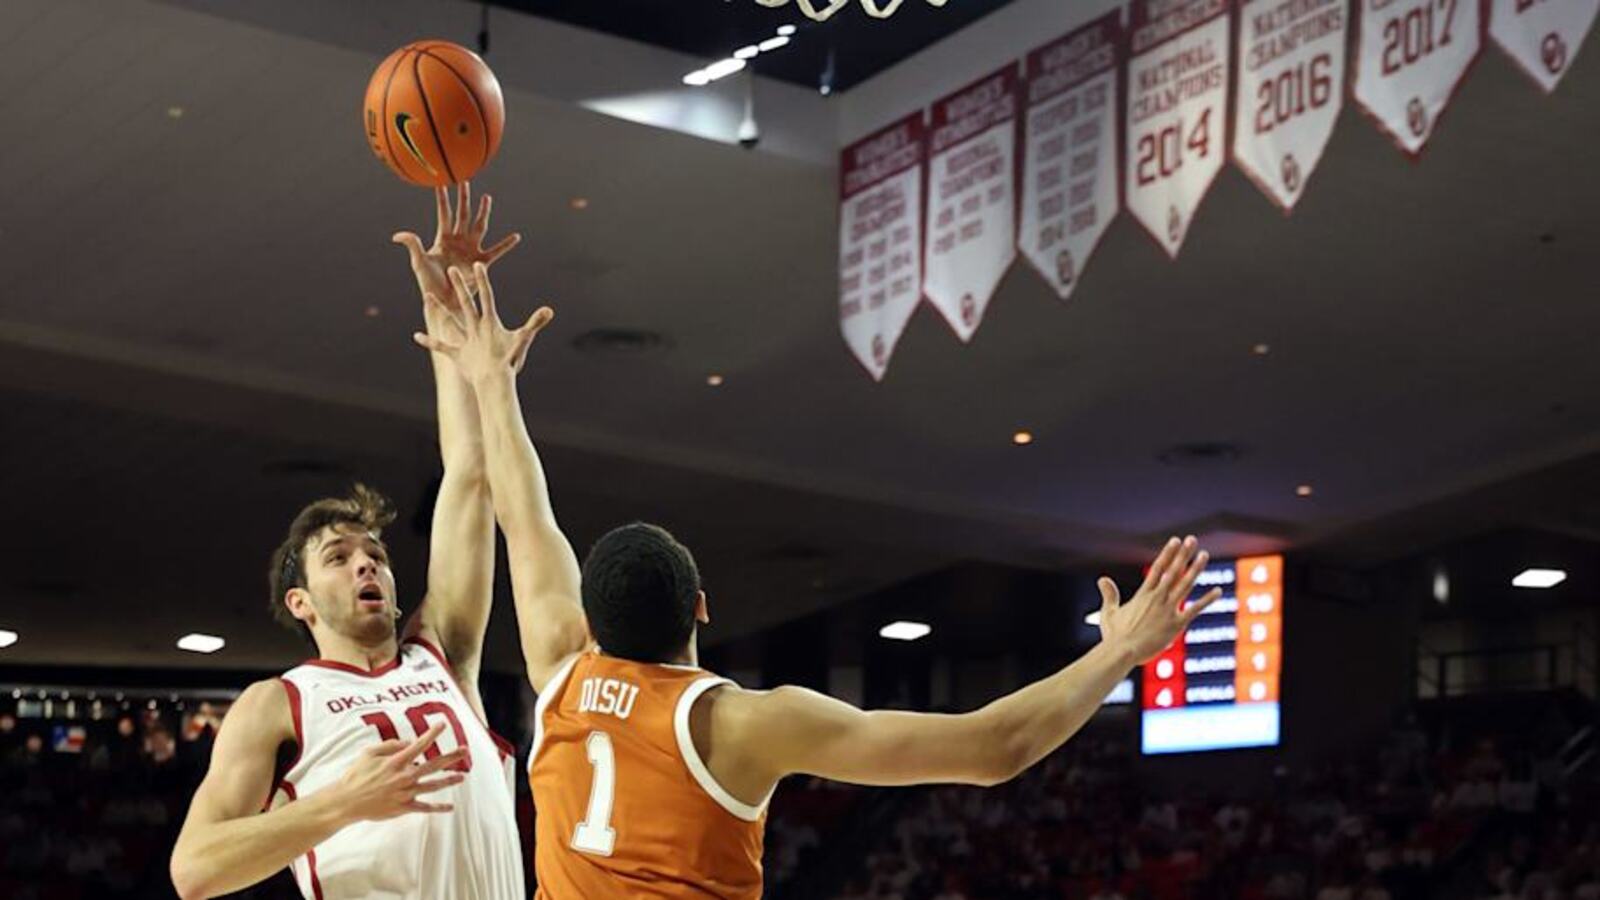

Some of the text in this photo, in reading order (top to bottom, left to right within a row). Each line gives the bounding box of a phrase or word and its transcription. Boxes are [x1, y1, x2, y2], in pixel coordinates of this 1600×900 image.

[1381, 0, 1457, 76] 2017
[1254, 53, 1332, 135] 2016
[1137, 108, 1211, 187] 2014
[326, 680, 449, 713] OKLAHOMA
[578, 678, 639, 719] DISU
[570, 731, 617, 857] 1
